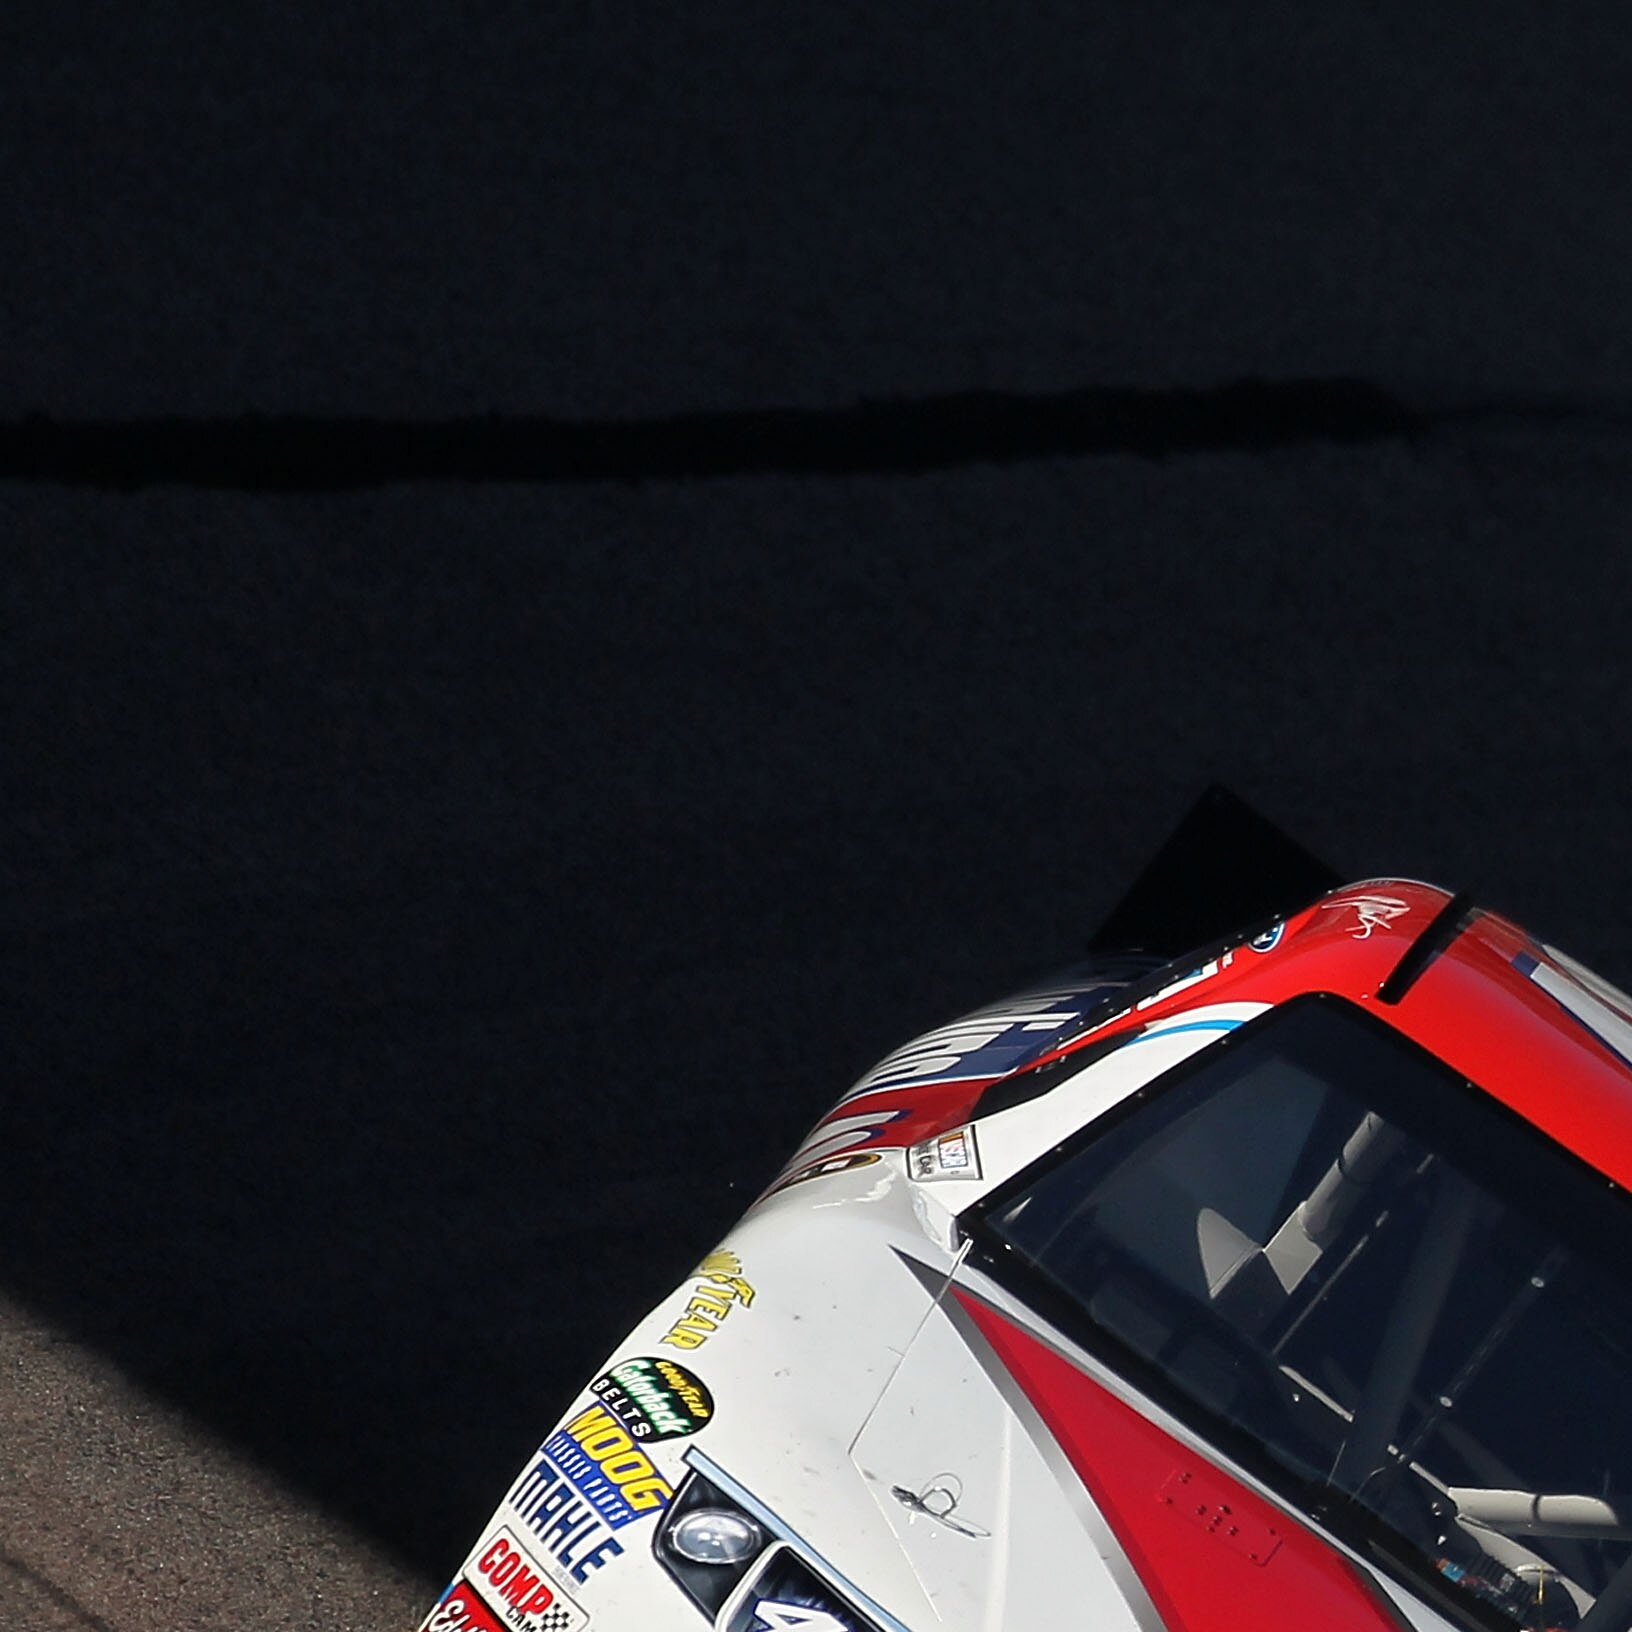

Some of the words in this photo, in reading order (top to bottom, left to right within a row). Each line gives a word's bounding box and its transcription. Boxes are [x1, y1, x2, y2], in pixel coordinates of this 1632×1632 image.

[592, 1379, 651, 1438] BELTS
[609, 1359, 690, 1435] Gatorback
[565, 1406, 674, 1511] MOOG
[508, 1459, 624, 1585] MAHLE
[478, 1538, 553, 1615] COMP
